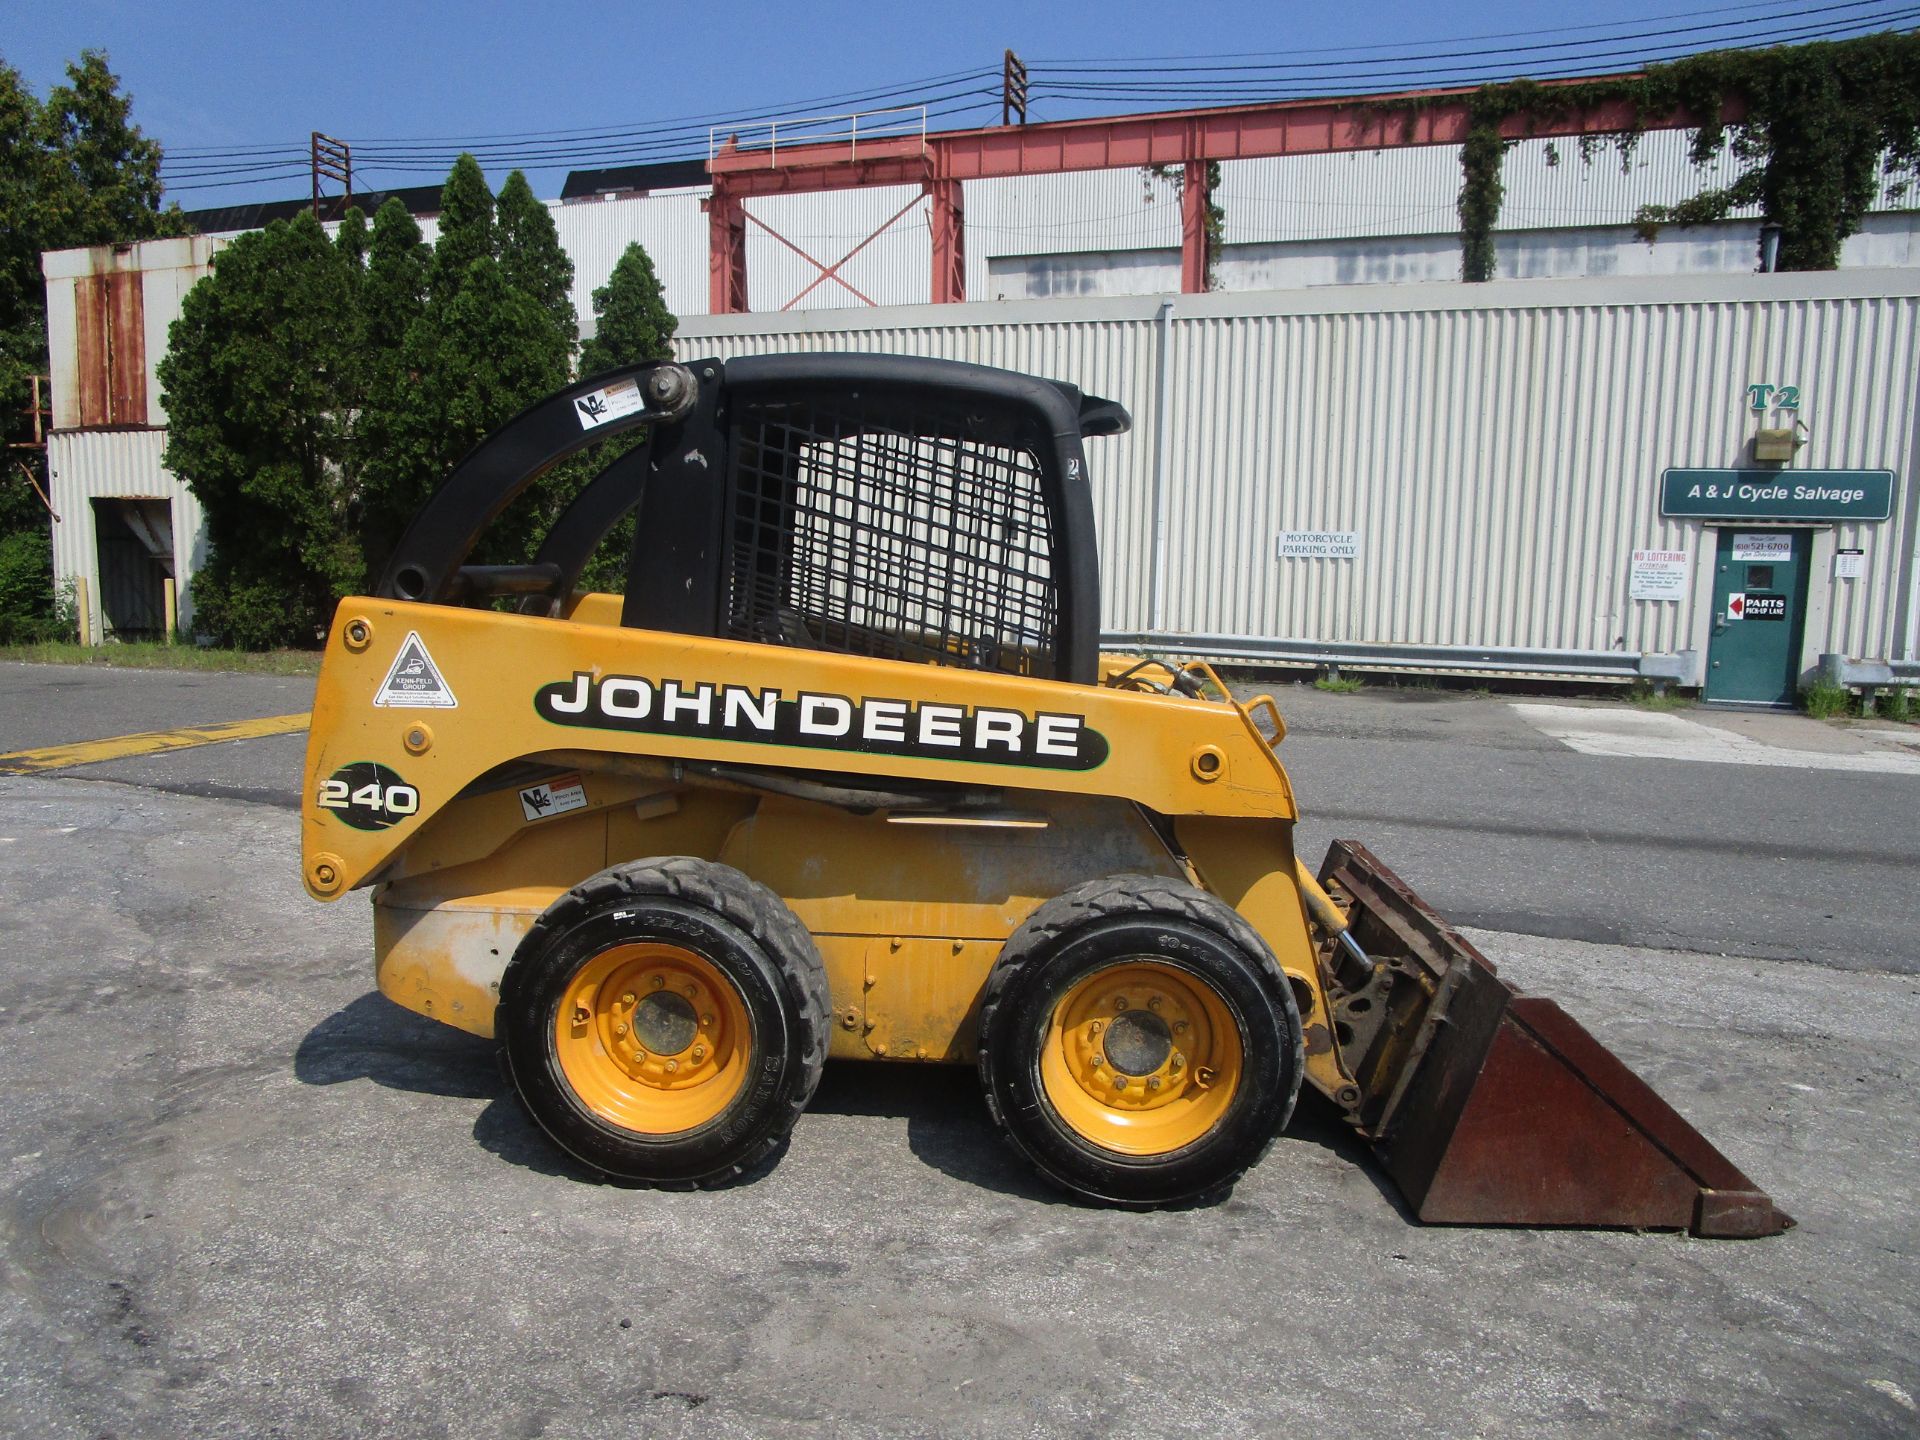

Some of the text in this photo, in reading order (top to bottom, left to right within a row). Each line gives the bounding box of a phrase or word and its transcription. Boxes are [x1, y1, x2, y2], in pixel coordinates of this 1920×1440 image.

[1747, 384, 1800, 410] T2
[1688, 485, 1864, 504] A & J Cycle Salvage
[1286, 534, 1353, 544] MOTORCYCLE
[1283, 545, 1357, 555] PARKING ONLY
[1751, 543, 1789, 551] 521-6700
[1634, 552, 1686, 562] NO LOITERING
[1746, 599, 1785, 607] PARTS
[550, 675, 1080, 757] JOHN DEERE
[318, 780, 418, 814] 240
